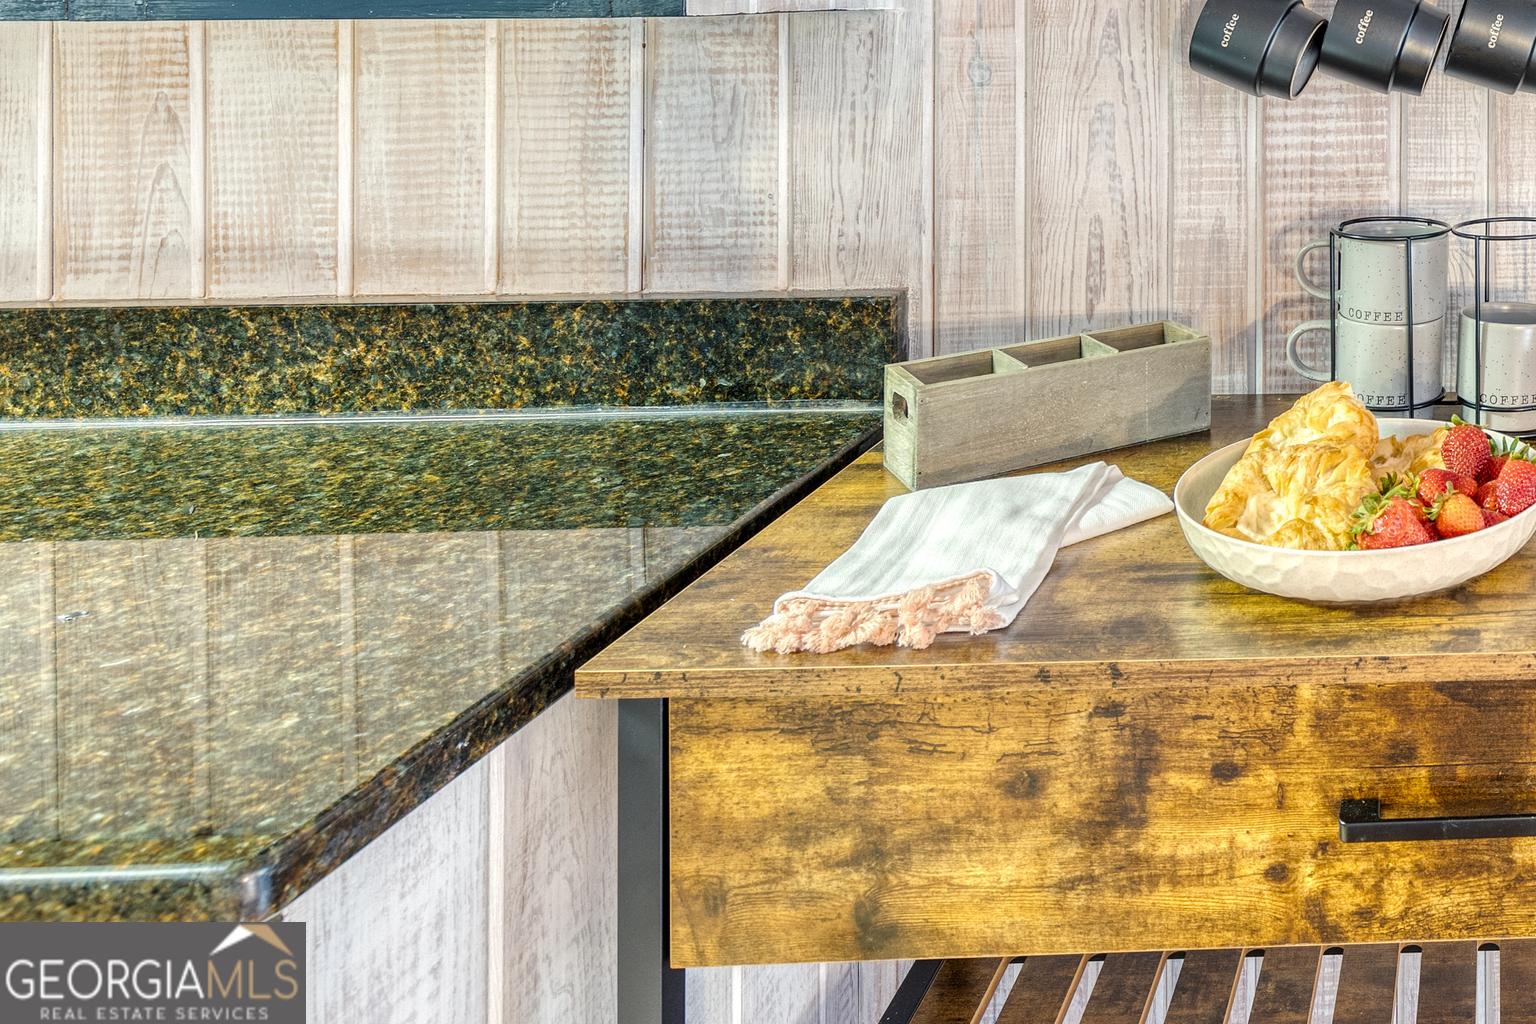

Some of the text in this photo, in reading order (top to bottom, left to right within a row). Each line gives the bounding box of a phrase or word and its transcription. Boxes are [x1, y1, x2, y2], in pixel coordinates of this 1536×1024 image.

[1220, 13, 1240, 48] coffee
[1355, 9, 1374, 45] coffee
[1487, 13, 1505, 49] coffee
[1348, 307, 1403, 322] COFFEE
[1356, 393, 1406, 406] OFFEE
